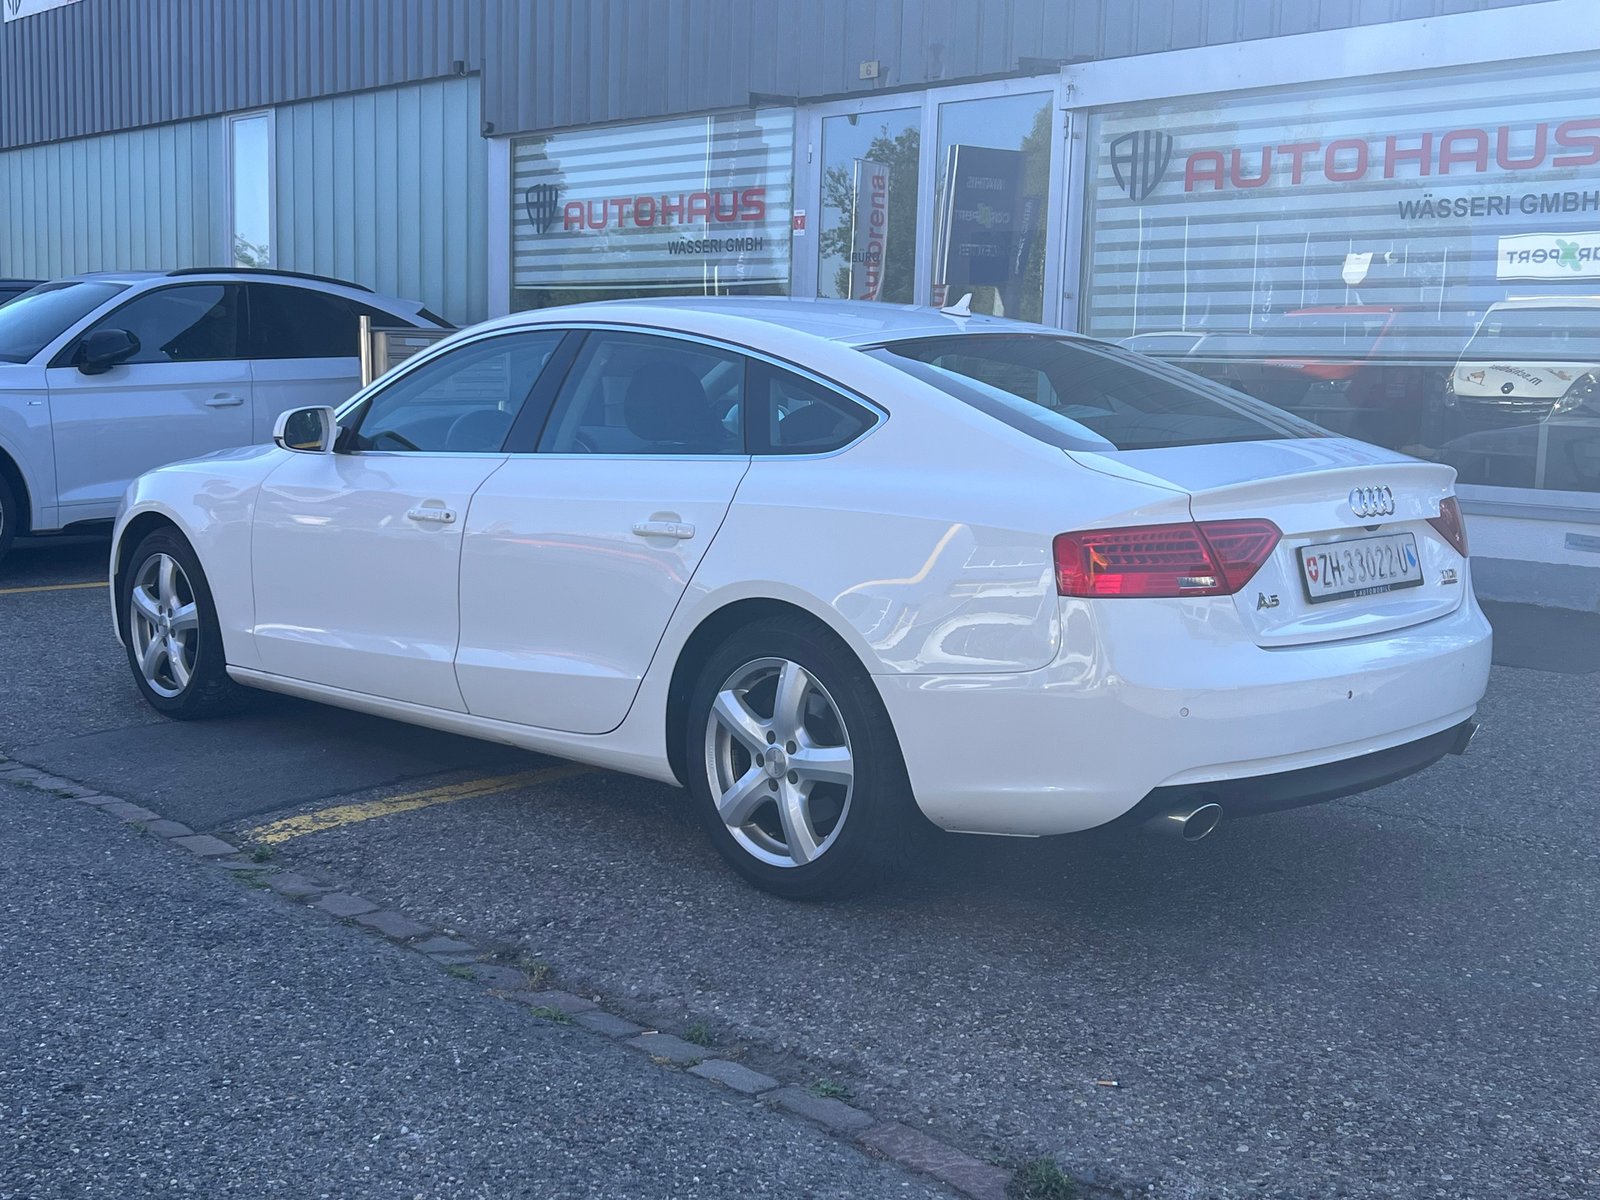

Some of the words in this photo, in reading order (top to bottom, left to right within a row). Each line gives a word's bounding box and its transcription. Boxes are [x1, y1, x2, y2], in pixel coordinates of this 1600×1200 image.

[1184, 118, 1600, 193] AUTOHAUS
[563, 188, 767, 231] AUTOHAUS
[1398, 193, 1511, 220] WÄSSERI
[1519, 190, 1600, 215] GMBH
[668, 236, 722, 255] WÄSSERI
[725, 237, 763, 253] GMBH
[1256, 592, 1280, 611] A5
